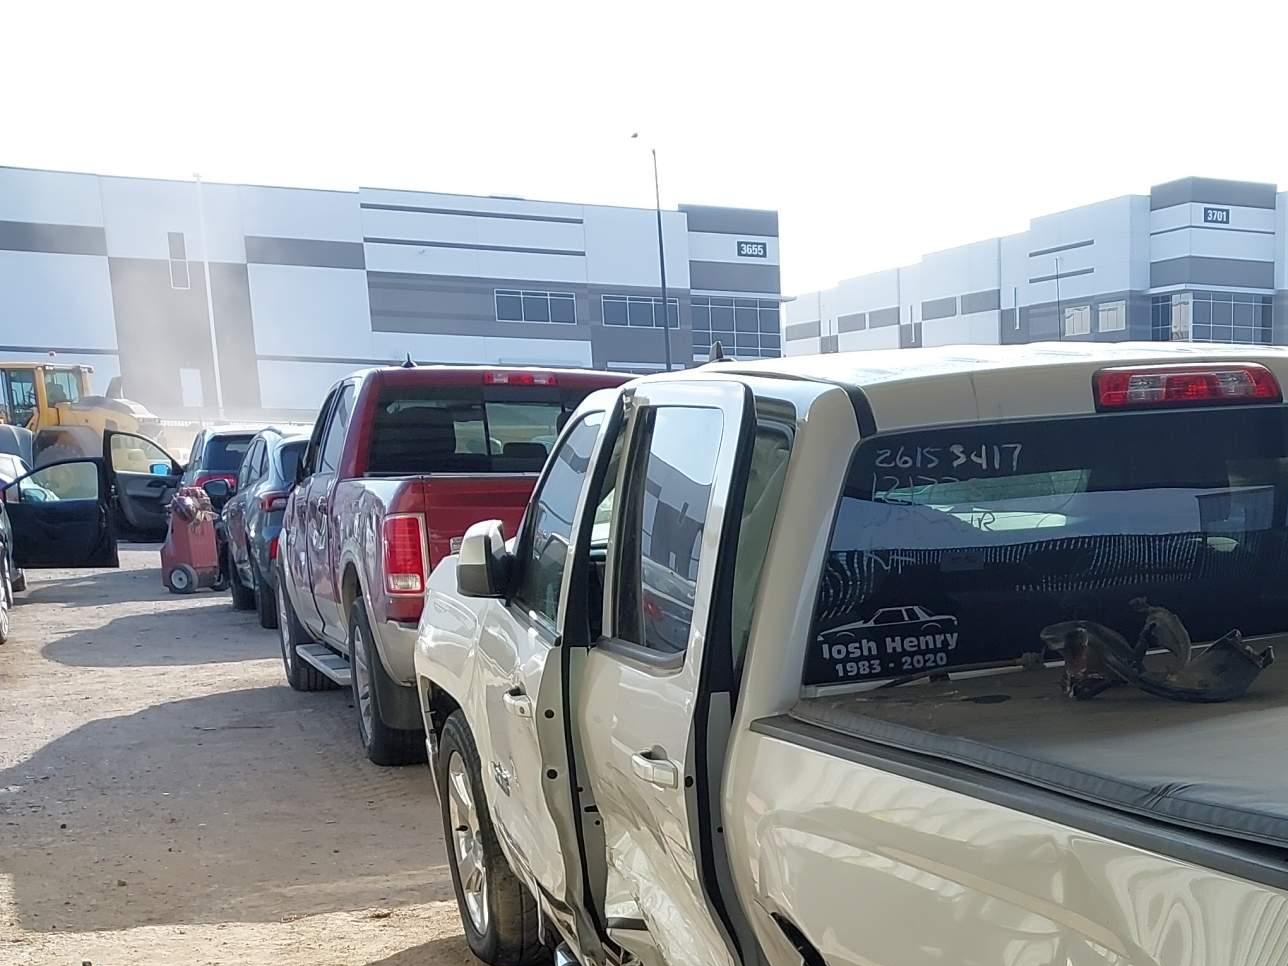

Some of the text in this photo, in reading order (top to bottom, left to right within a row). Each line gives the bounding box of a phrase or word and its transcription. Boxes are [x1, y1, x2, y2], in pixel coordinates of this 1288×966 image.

[1207, 209, 1227, 222] 3701
[740, 243, 764, 256] 3655
[885, 632, 959, 653] Henry
[835, 659, 882, 677] 1983
[901, 652, 948, 669] 2020
